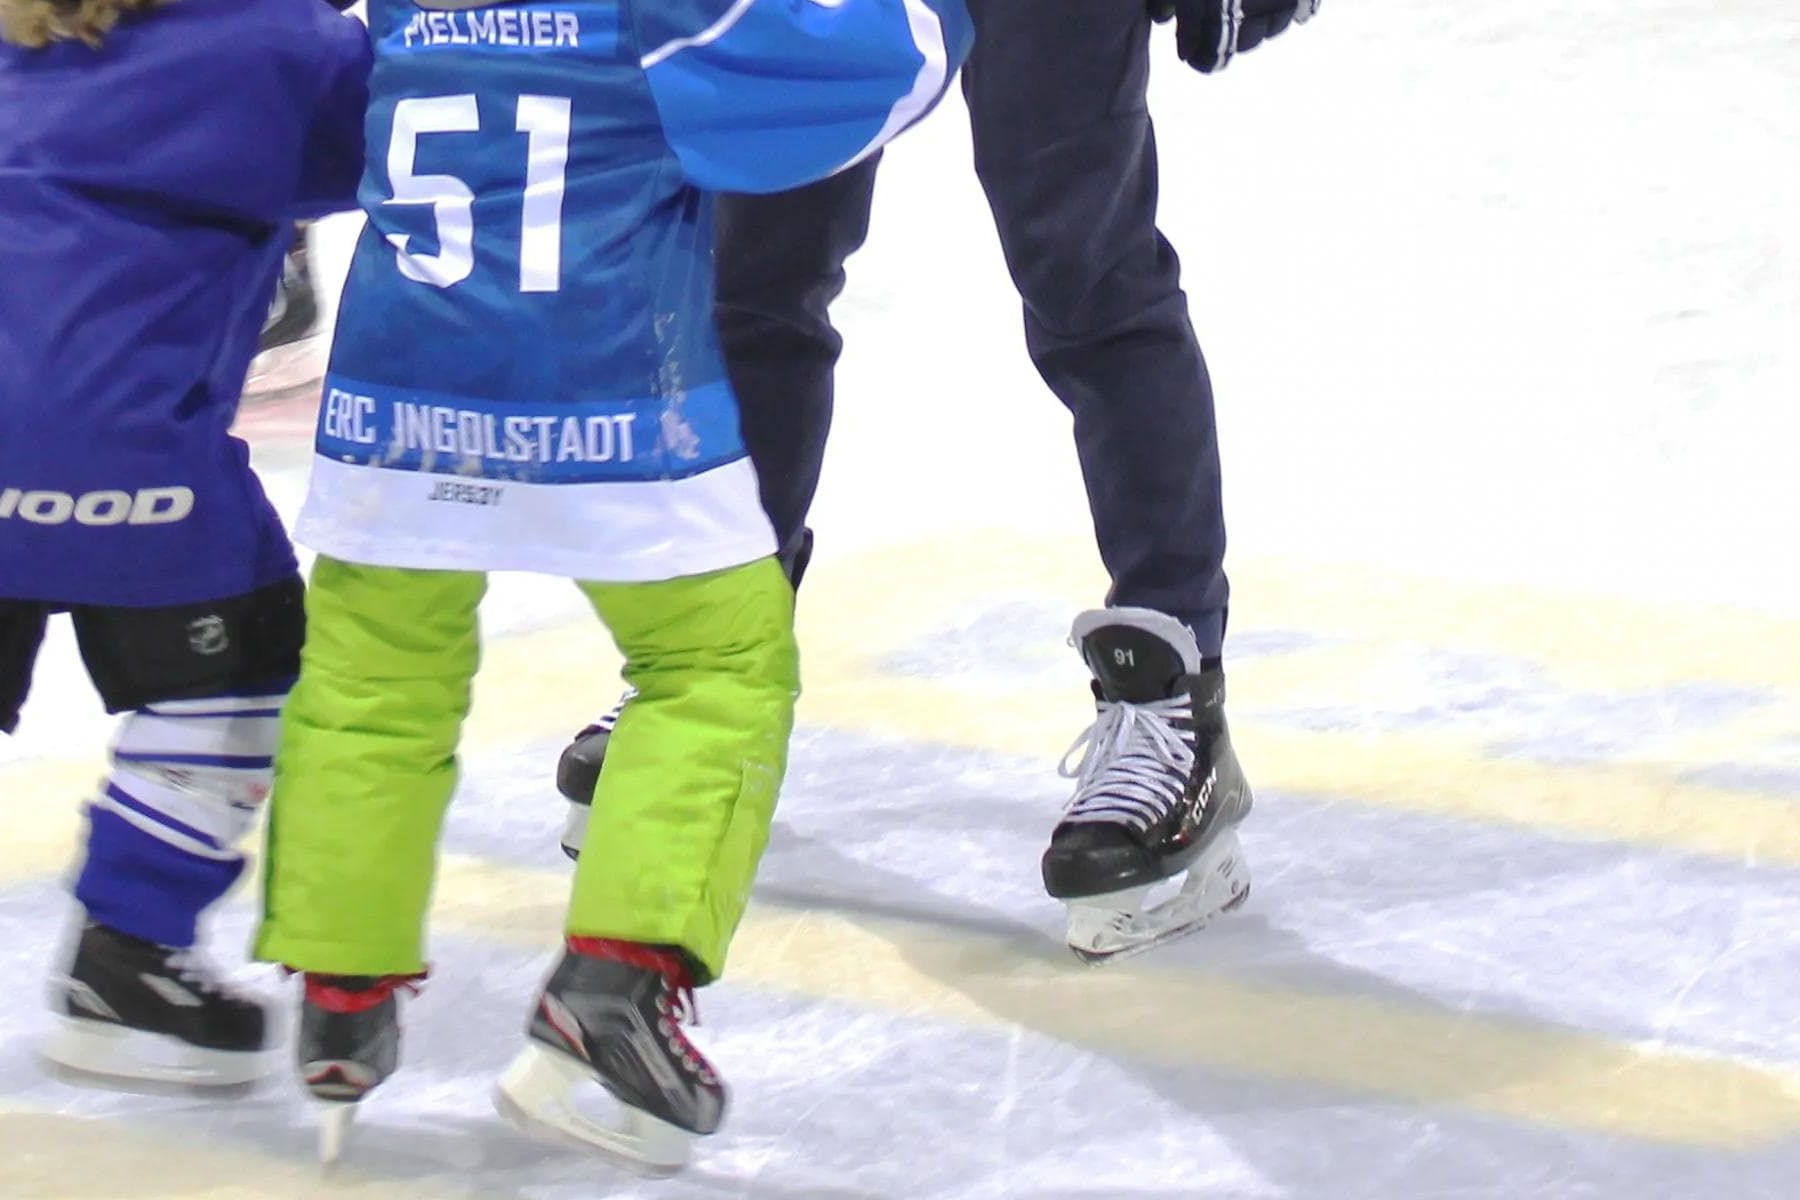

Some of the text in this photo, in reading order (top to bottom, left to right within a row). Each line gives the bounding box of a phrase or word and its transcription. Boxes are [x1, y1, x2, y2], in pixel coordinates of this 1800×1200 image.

[382, 94, 571, 292] 51
[325, 388, 638, 463] ERC INGOLSTADT
[1113, 648, 1135, 667] 91
[1192, 766, 1218, 825] CCM
